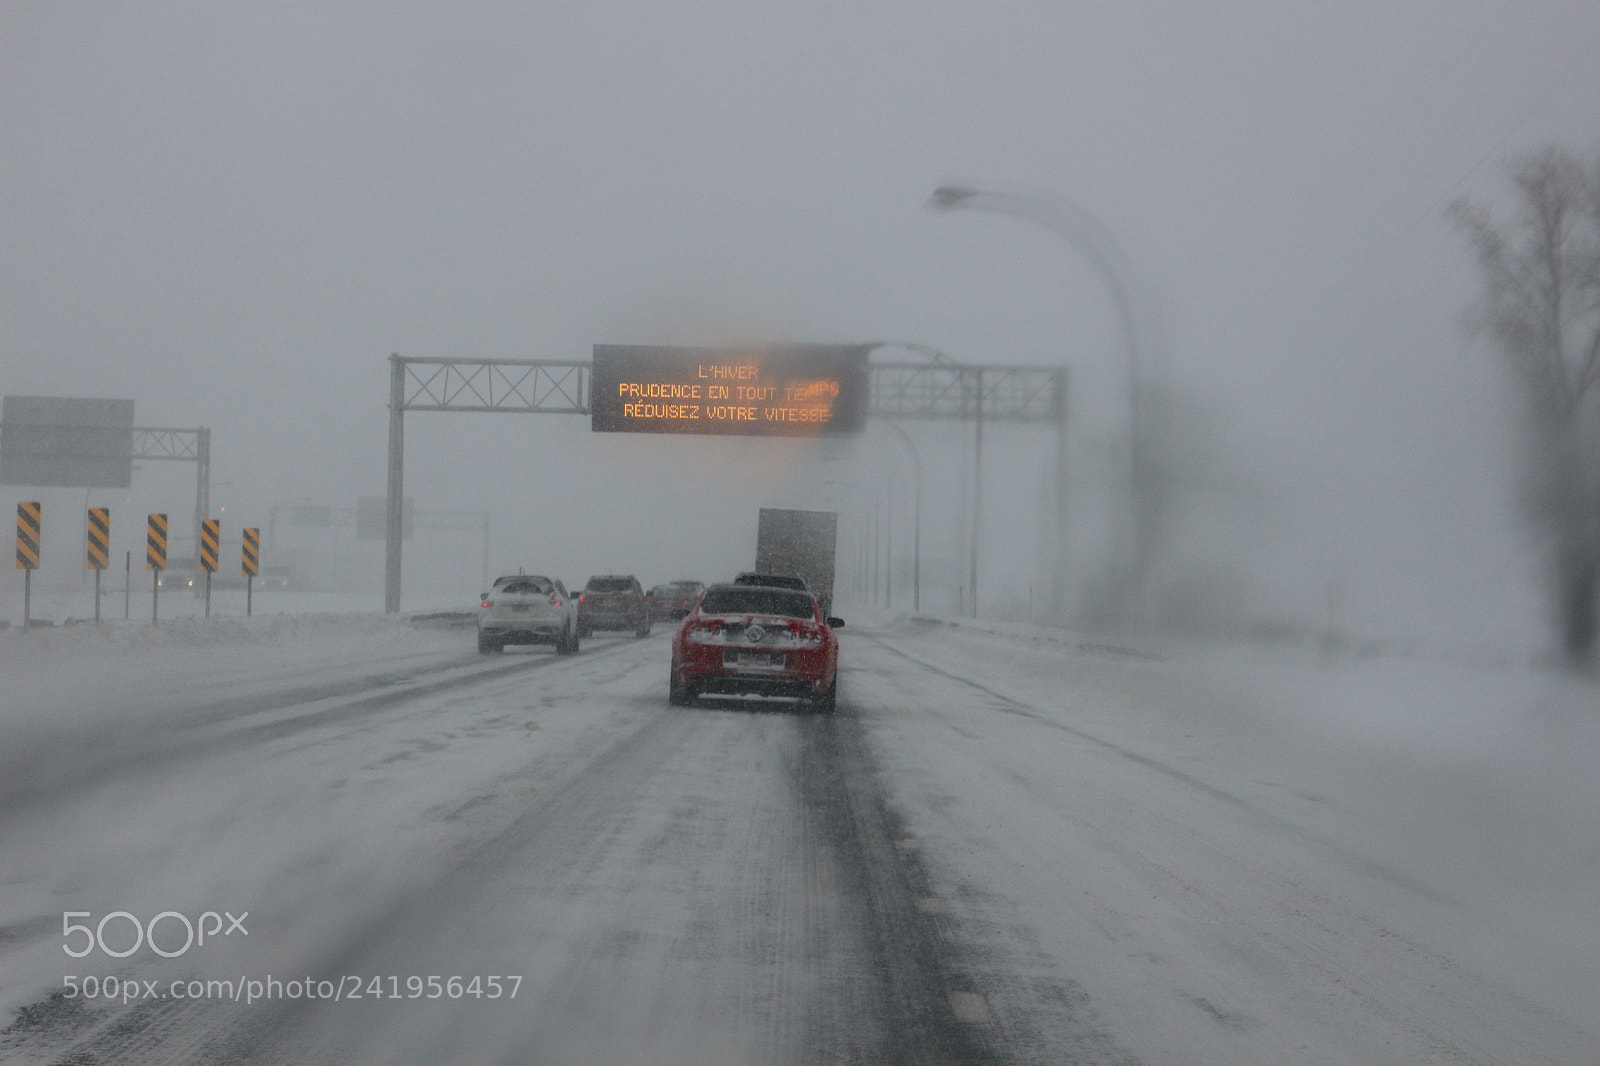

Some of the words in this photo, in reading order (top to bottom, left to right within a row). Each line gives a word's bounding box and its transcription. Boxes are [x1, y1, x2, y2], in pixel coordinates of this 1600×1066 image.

[698, 364, 759, 380] L'HIVER
[618, 382, 701, 399] PRUDENCE
[708, 385, 729, 400] EN
[736, 386, 777, 401] TOUT
[624, 399, 700, 419] RÉDUISEZ
[706, 405, 758, 421] VOTRE
[764, 407, 832, 423] VITESSE
